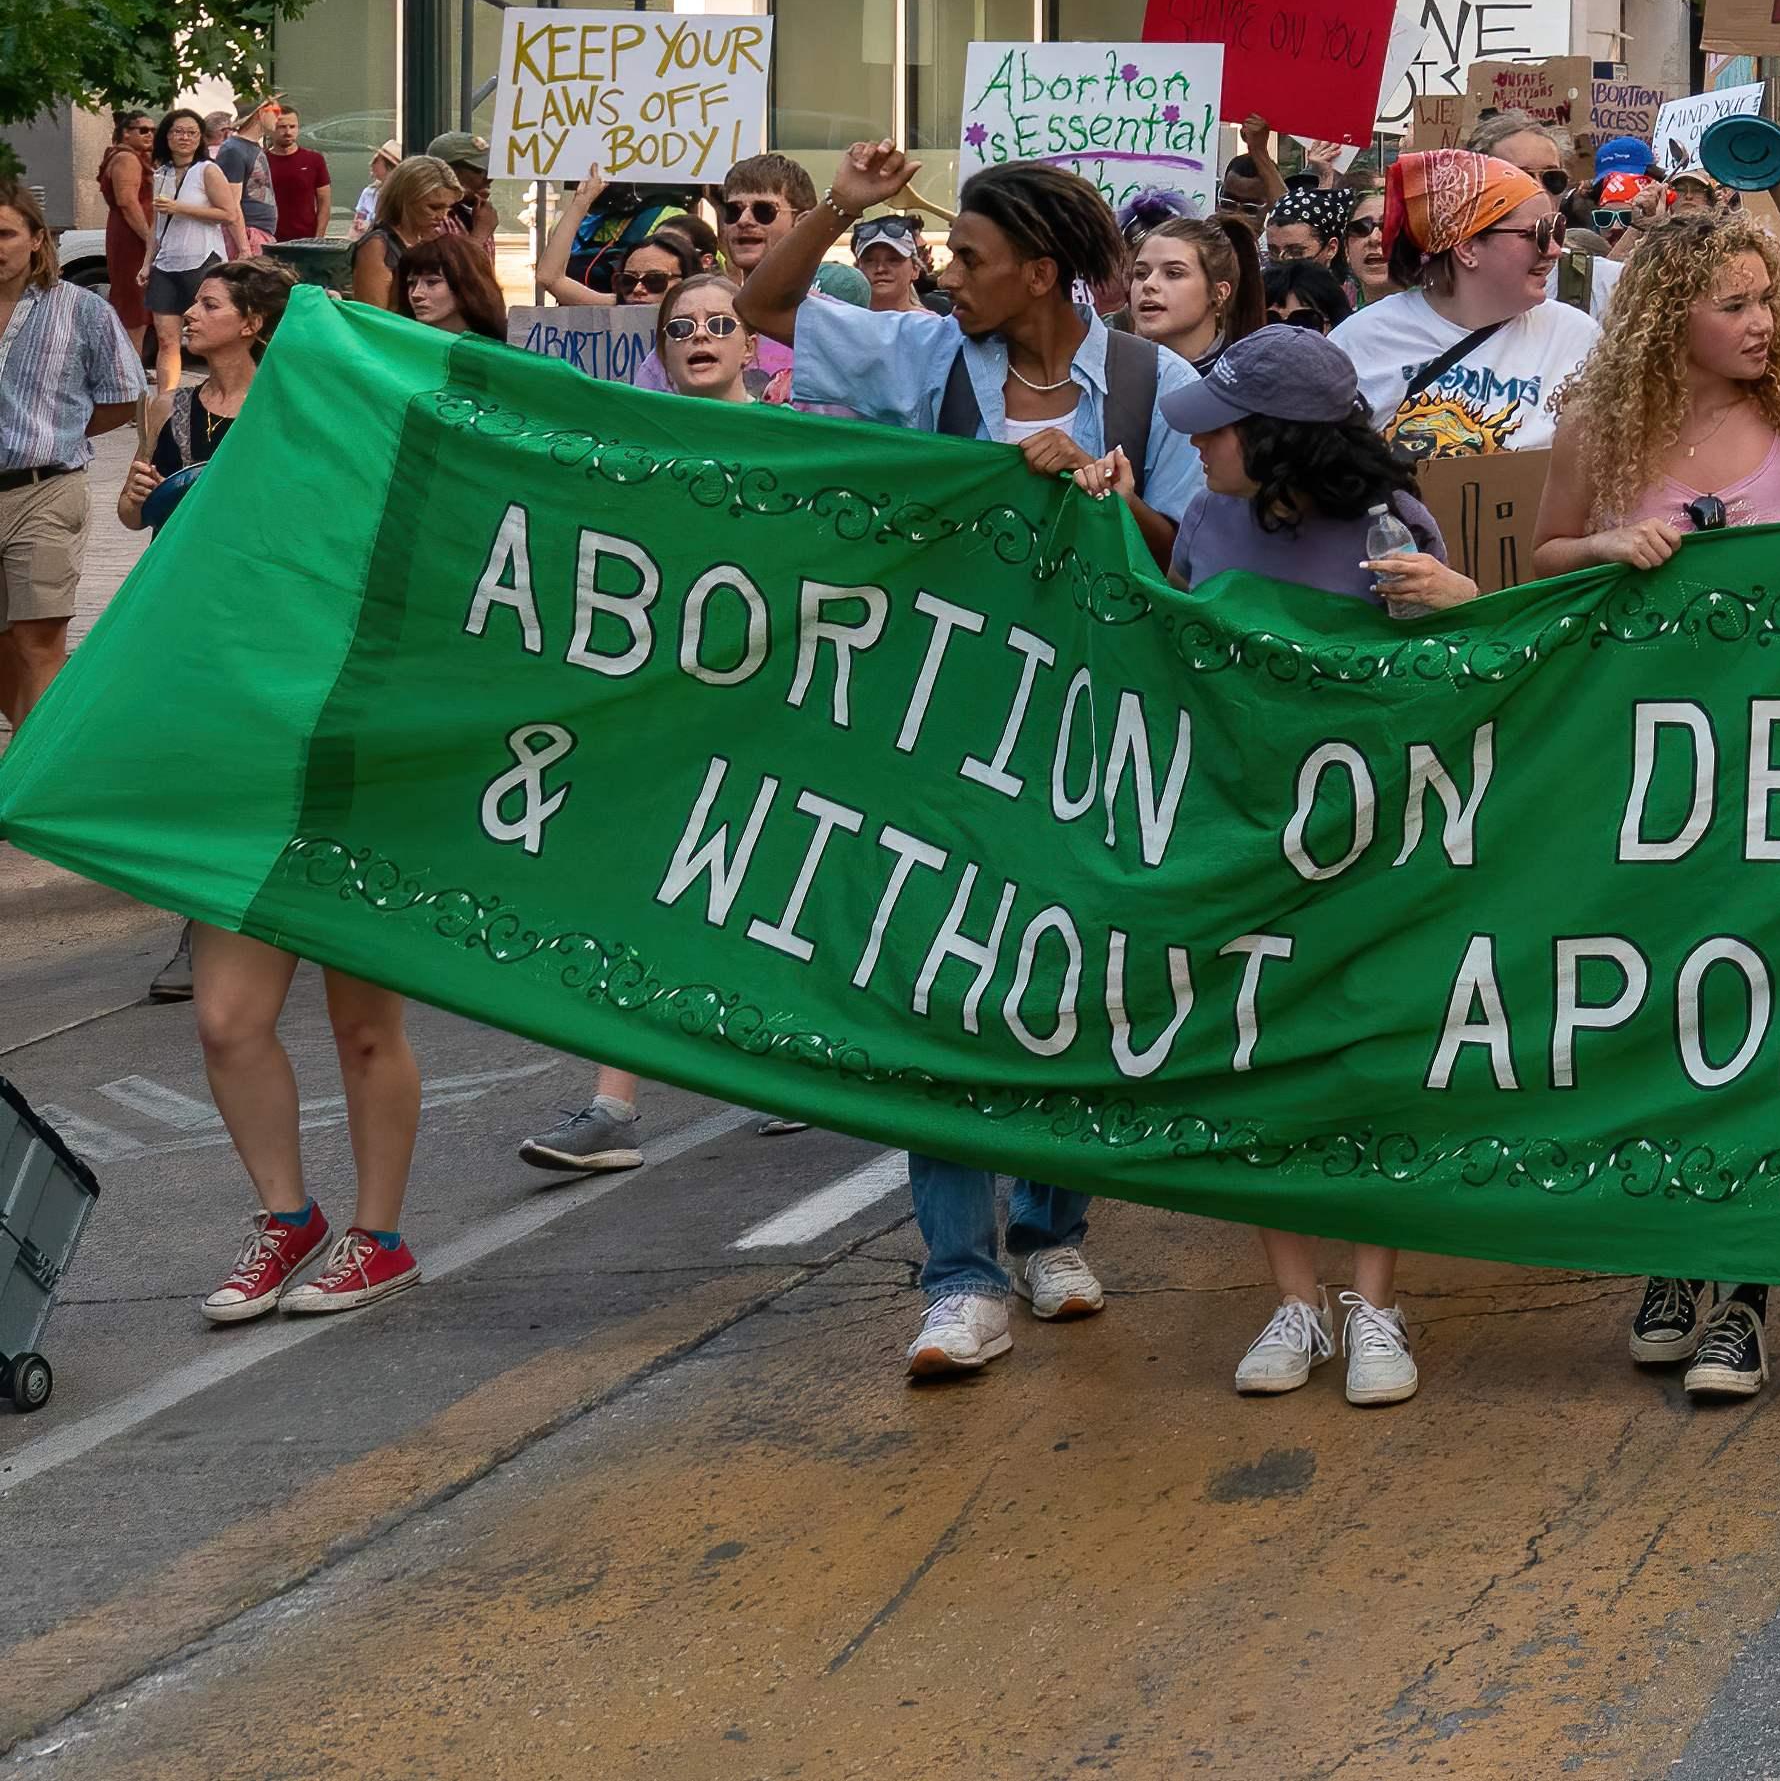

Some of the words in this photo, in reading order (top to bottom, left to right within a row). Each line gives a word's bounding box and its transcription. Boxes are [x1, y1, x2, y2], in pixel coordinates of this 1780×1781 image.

[511, 21, 647, 86] KEEP
[655, 20, 764, 78] YOUR
[1270, 11, 1306, 60] ON
[1322, 18, 1372, 69] YOU
[511, 84, 624, 131] LAWS
[639, 83, 729, 127] OFF
[970, 49, 1191, 113] Abortion
[1014, 104, 1214, 157] Essential
[1591, 107, 1649, 132] ACCESS
[1666, 103, 1709, 133] MIND
[507, 128, 569, 175] MY
[465, 503, 1191, 867] ABORTION
[1281, 722, 1497, 882] ON
[479, 723, 575, 854] &
[655, 756, 1295, 1080] WITHOUT
